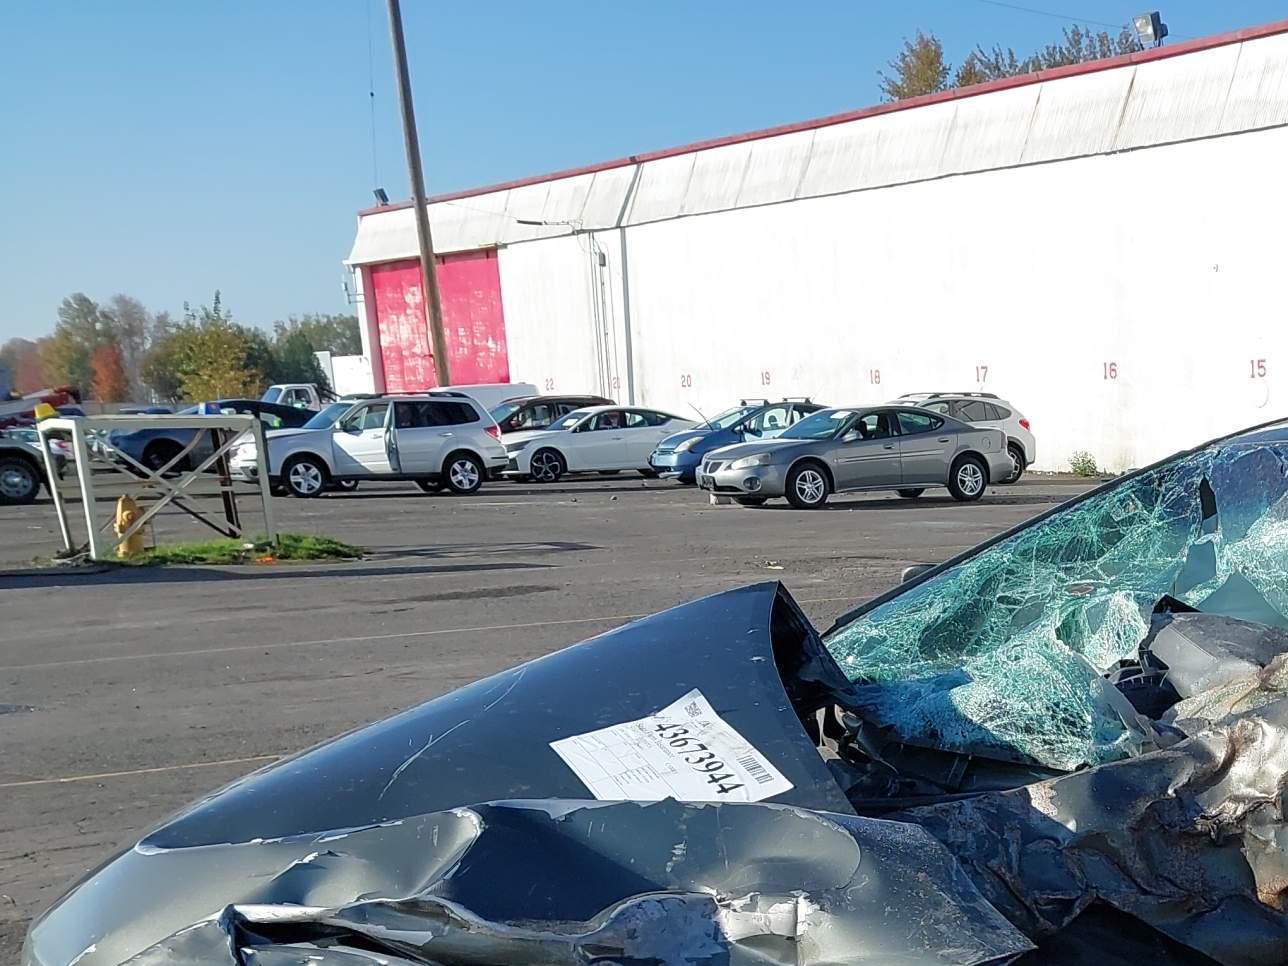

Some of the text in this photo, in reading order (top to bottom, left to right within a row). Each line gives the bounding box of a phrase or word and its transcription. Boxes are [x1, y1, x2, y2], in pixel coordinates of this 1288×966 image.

[869, 368, 882, 386] 18
[975, 365, 989, 383] 17
[1103, 361, 1118, 381] 16
[1250, 358, 1267, 379] 15
[545, 377, 556, 392] 22
[680, 373, 693, 388] 20
[760, 370, 772, 386] 19
[653, 721, 747, 796] 43673944
